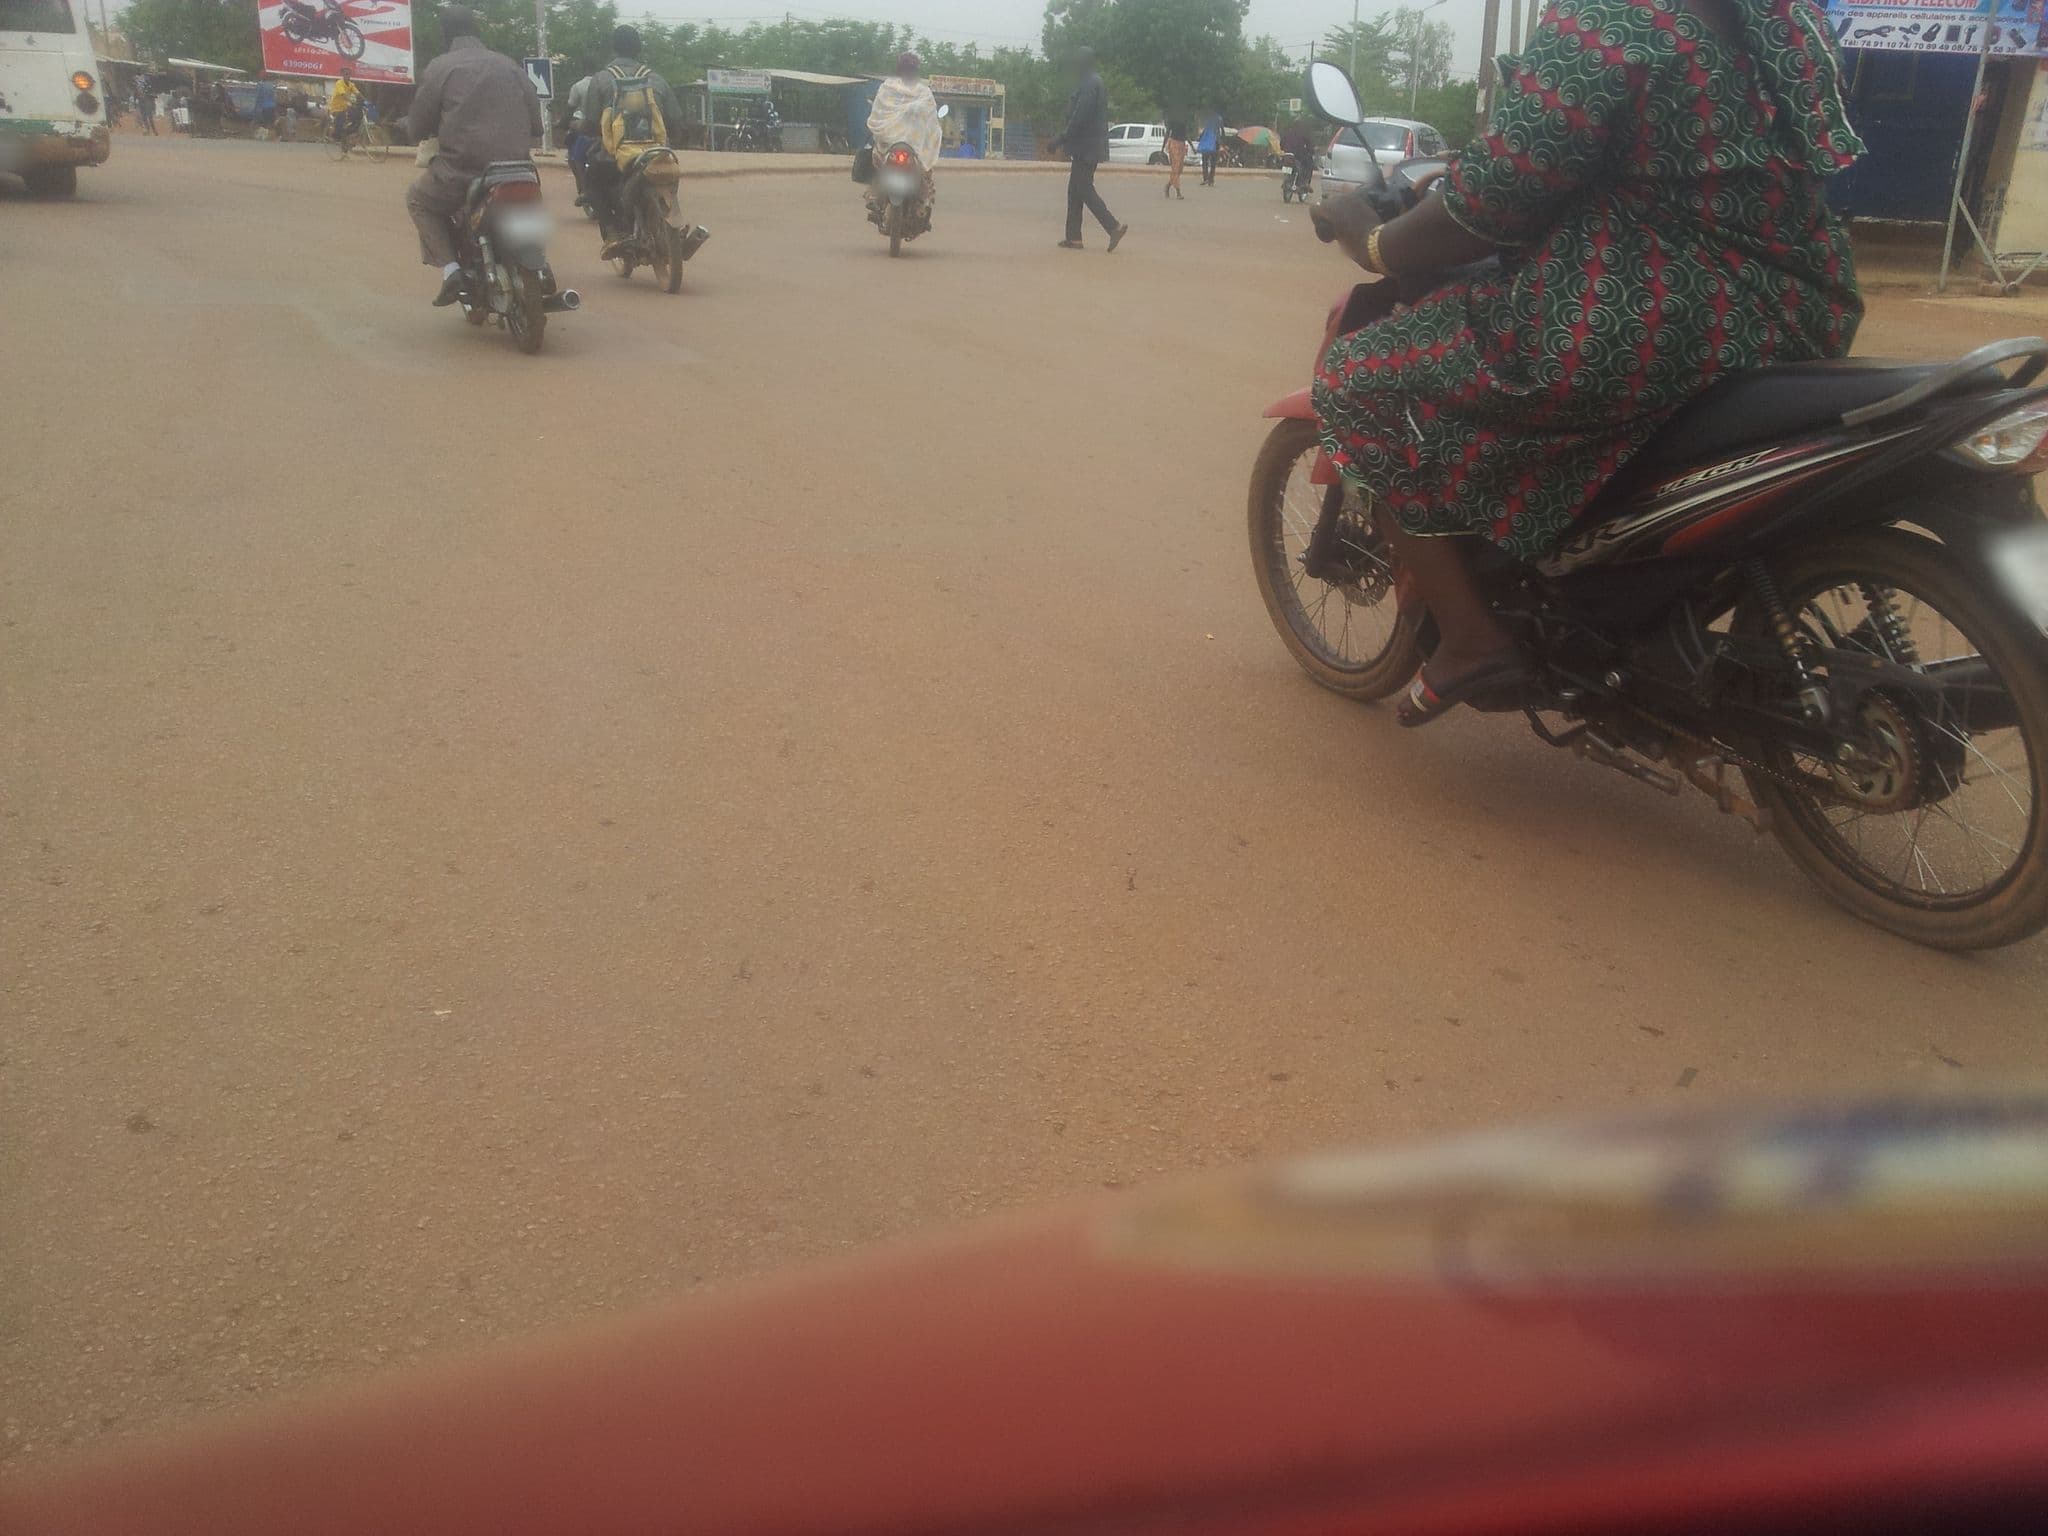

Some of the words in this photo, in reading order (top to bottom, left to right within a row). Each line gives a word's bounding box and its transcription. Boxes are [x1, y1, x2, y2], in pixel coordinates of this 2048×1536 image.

[1847, 10, 1864, 18] des
[1866, 11, 1908, 19] appareils
[1910, 12, 1956, 20] cellulaires
